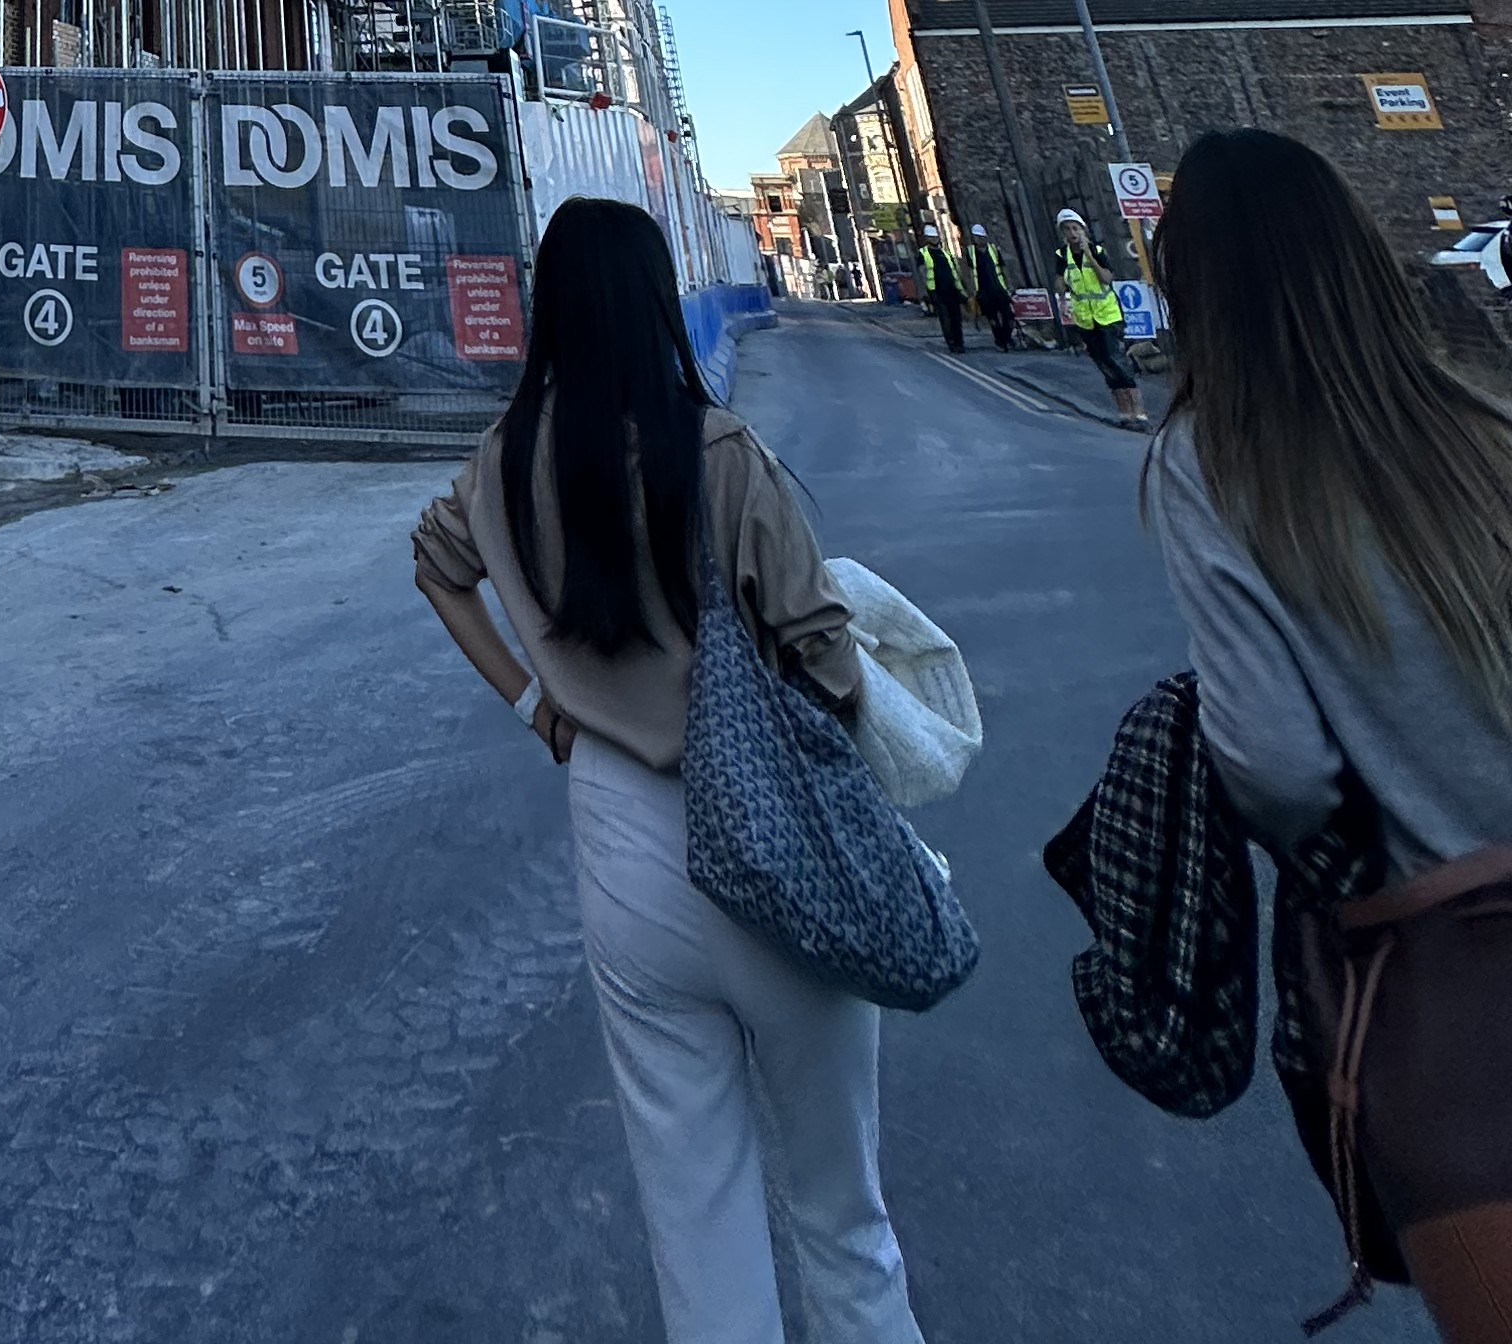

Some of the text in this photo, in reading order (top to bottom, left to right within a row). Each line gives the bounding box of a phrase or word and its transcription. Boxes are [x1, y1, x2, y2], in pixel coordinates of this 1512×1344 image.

[1375, 87, 1410, 97] Event
[1379, 98, 1427, 109] Parking
[221, 104, 499, 191] DOMIS
[1128, 174, 1139, 187] 5
[128, 251, 177, 265] Reversing
[452, 258, 506, 272] Reversing
[129, 267, 179, 278] prohibited
[251, 265, 267, 288] 5
[314, 252, 425, 291] GATE
[455, 273, 509, 285] prohibited
[138, 280, 171, 291] unless
[466, 287, 501, 298] unless
[140, 293, 170, 304] under
[470, 301, 501, 312] under
[132, 307, 177, 318] direction
[34, 304, 60, 334] 4
[464, 315, 512, 326] direction
[145, 321, 165, 332] of a
[234, 319, 294, 334] Max Speed
[361, 310, 388, 345] 4
[479, 329, 500, 340] of a
[129, 335, 180, 346] banksman
[247, 335, 285, 347] on site
[464, 344, 519, 355] banksman
